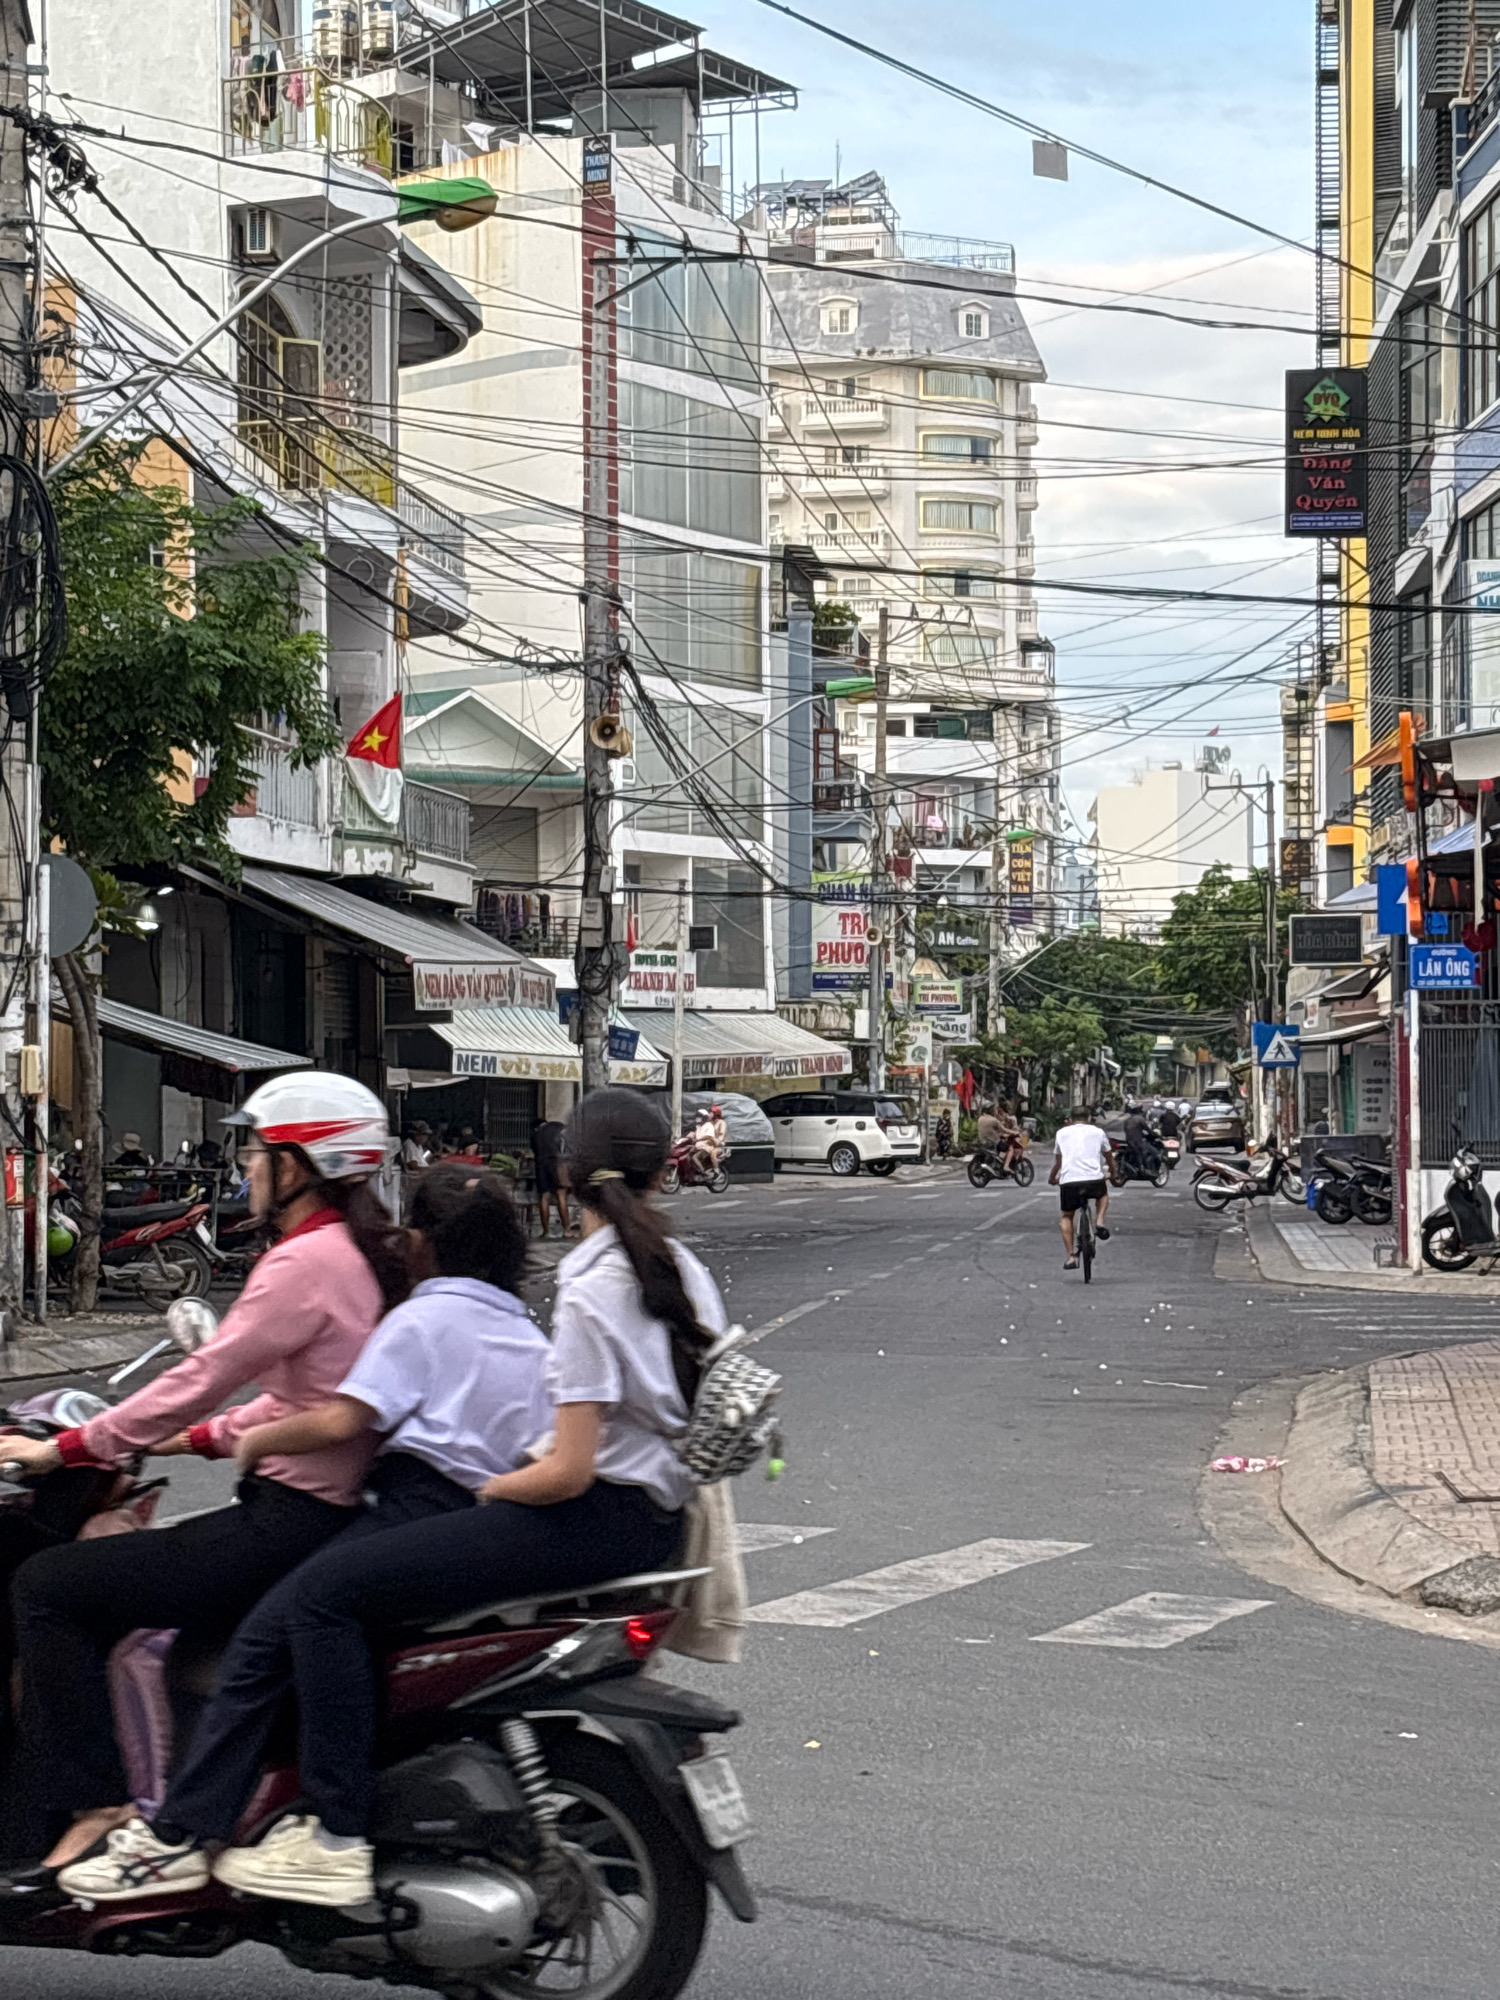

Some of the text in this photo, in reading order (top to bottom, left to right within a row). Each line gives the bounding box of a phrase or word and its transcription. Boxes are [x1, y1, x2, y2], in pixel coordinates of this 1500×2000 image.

[1293, 429, 1315, 439] NEM
[1317, 428, 1339, 439] NINH
[1445, 957, 1470, 977] ÔNG
[628, 972, 664, 991] THANH
[456, 1053, 497, 1074] NEM
[775, 1059, 799, 1077] LUCKY
